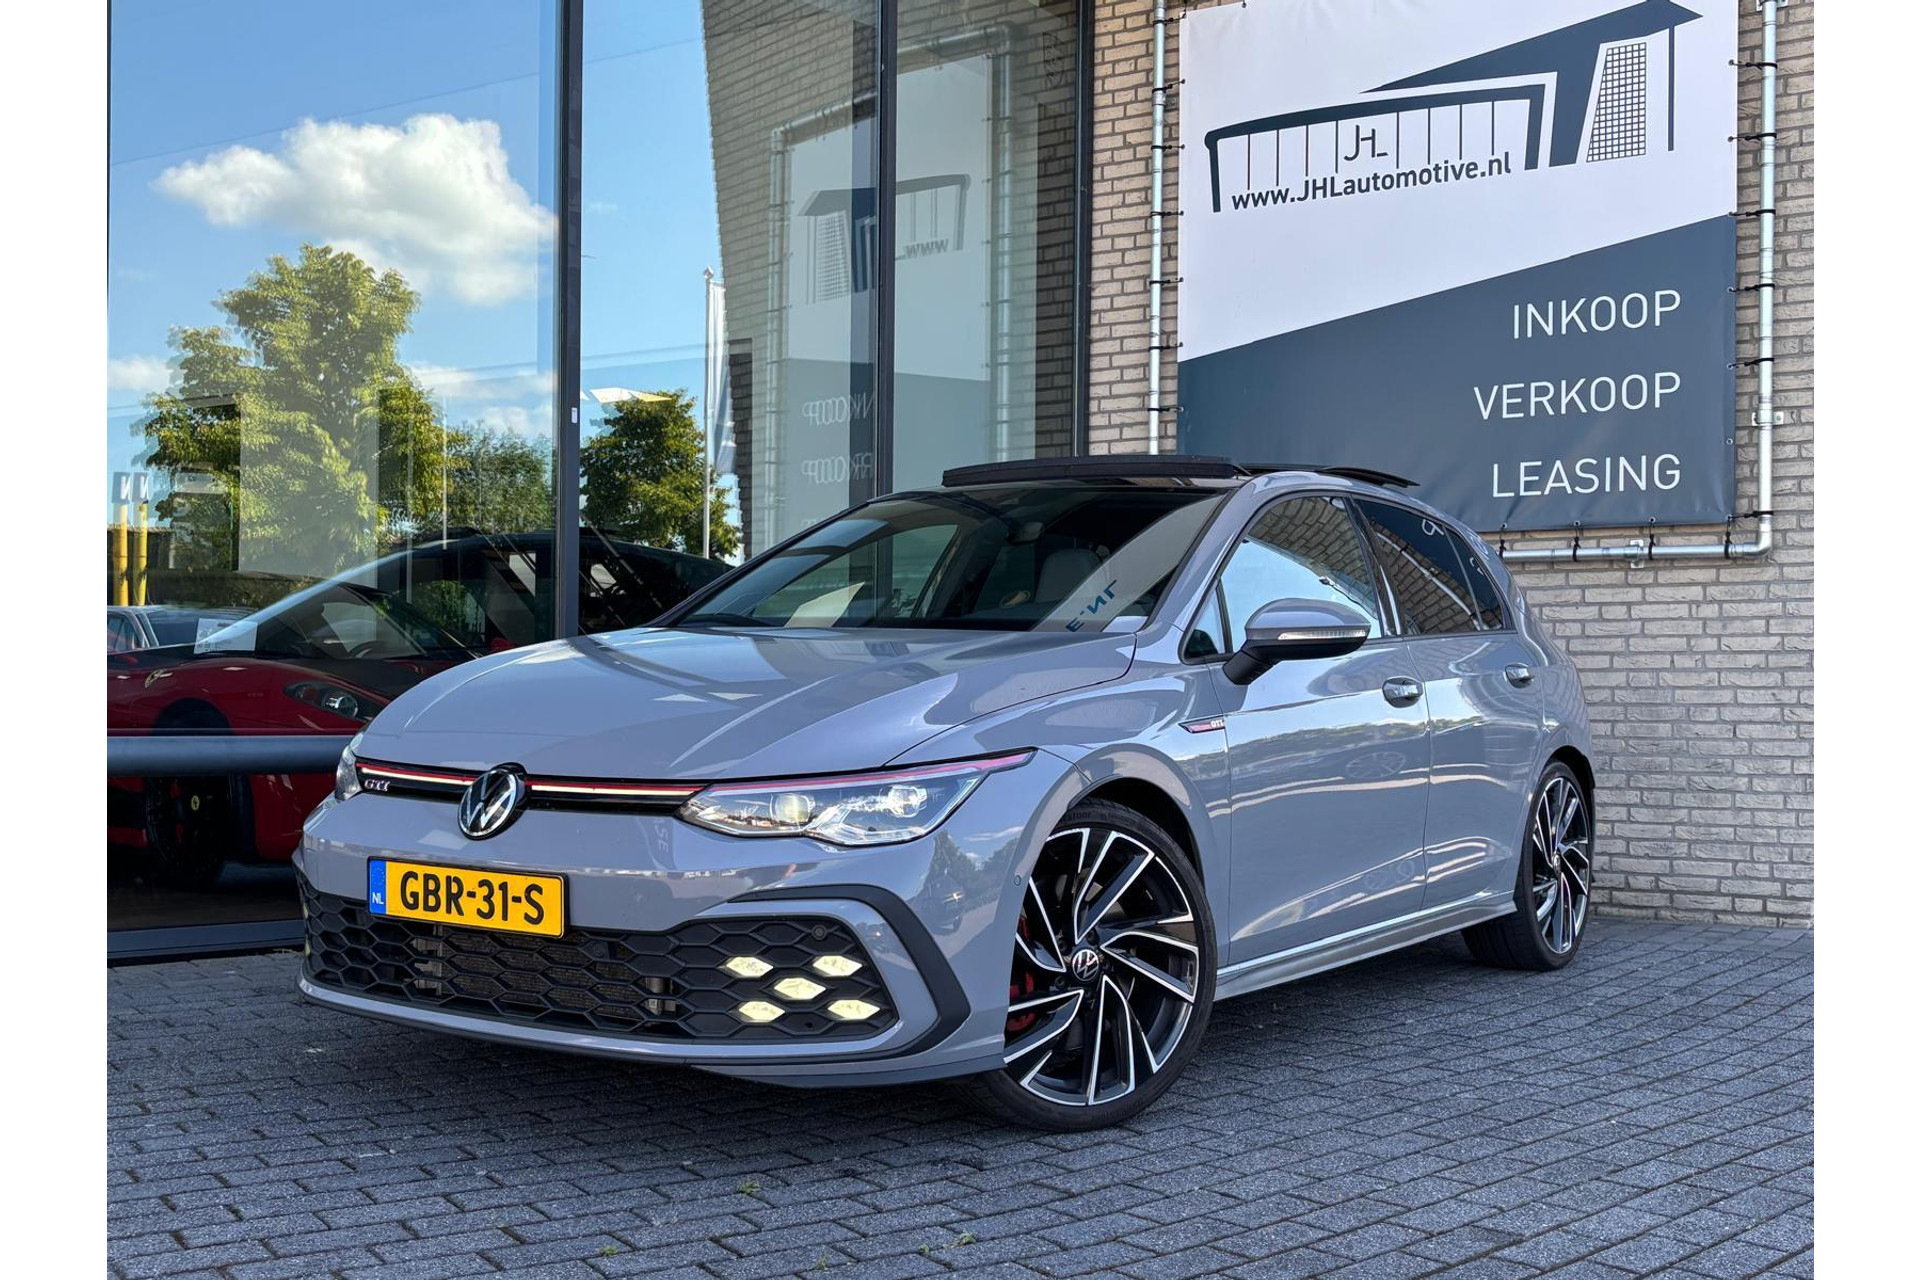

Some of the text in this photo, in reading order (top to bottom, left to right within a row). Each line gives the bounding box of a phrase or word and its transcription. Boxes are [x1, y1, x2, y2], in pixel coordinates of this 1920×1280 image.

[1231, 151, 1512, 210] www.JHLautomotive.nl
[1513, 289, 1682, 339] INKOOP
[1473, 371, 1682, 420] VERKOOP
[1492, 453, 1682, 498] LEASING
[363, 778, 391, 792] GTI
[372, 892, 385, 905] NL
[400, 870, 545, 926] GBR-31-S
